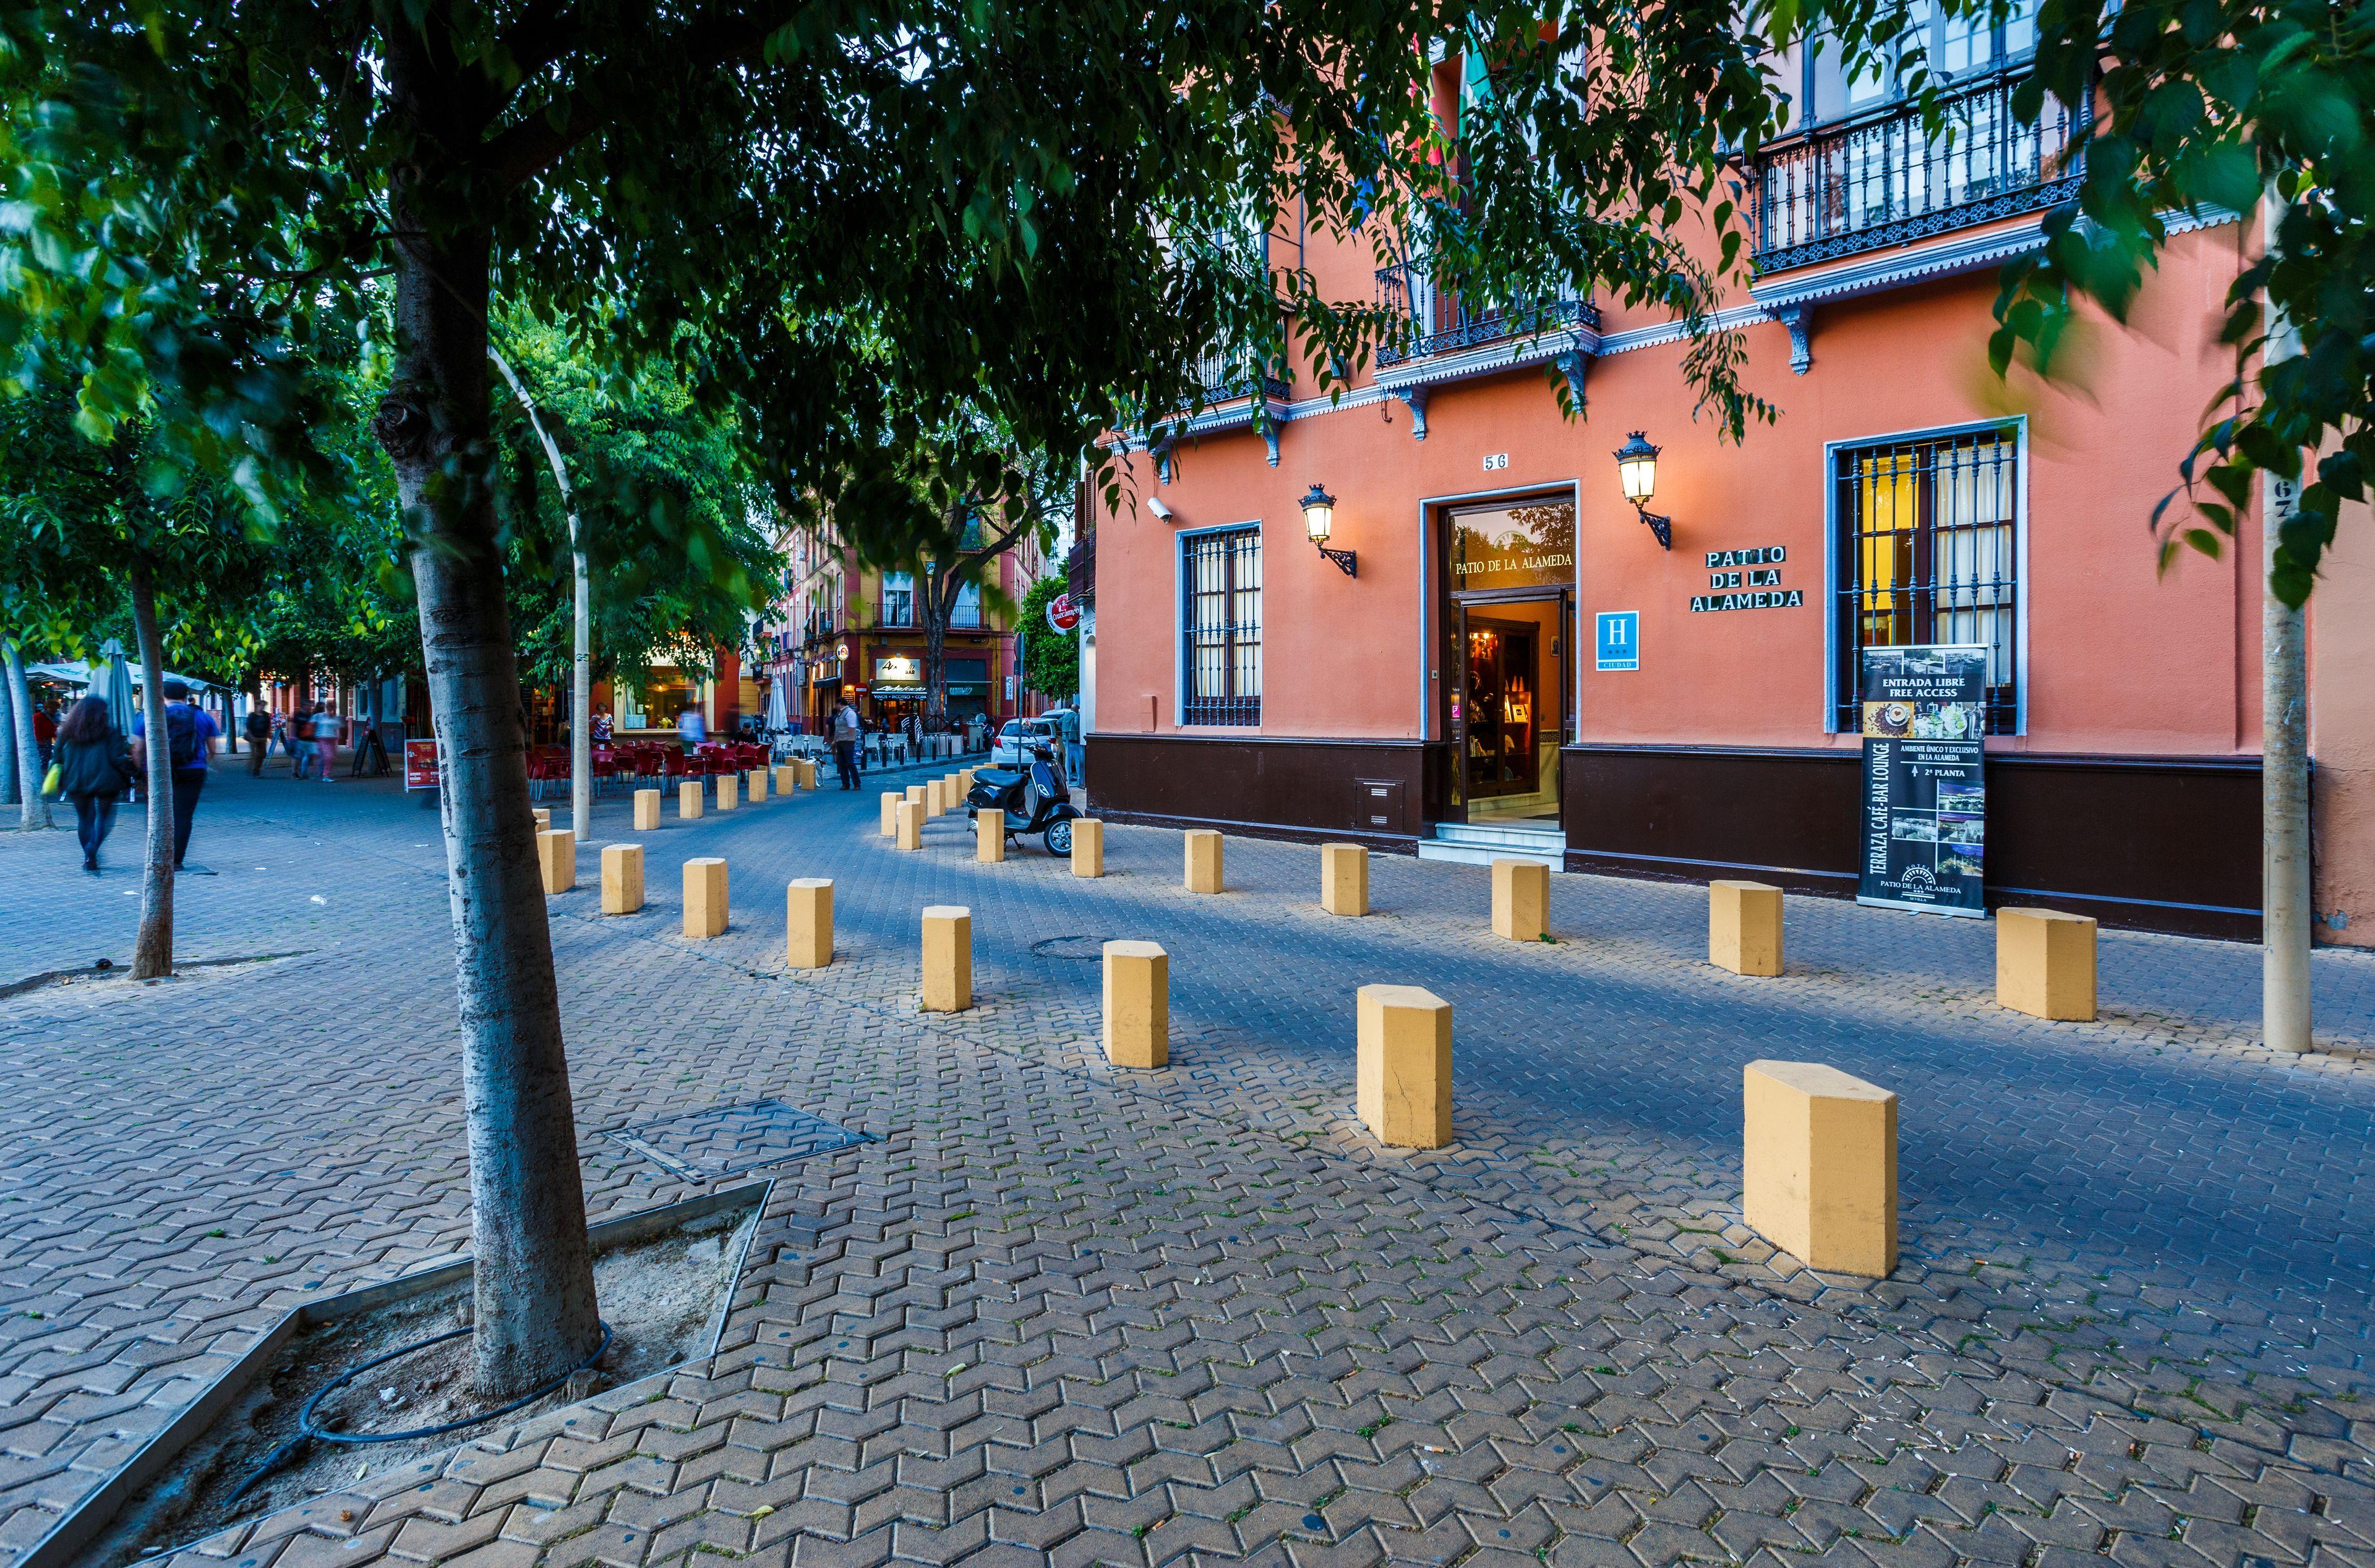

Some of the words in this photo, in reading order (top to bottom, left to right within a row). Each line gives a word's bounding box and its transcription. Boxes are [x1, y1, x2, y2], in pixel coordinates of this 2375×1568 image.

[1485, 454, 1506, 470] 56
[1455, 561, 1484, 575] PATIO
[1487, 560, 1502, 573] DE
[1504, 558, 1517, 571] LA
[1521, 553, 1573, 569] ALAMEDA
[1706, 546, 1785, 568] PATIO
[1711, 572, 1740, 589] DE
[1748, 569, 1779, 587] LA
[1690, 590, 1802, 612] ALAMEDA
[1053, 608, 1080, 621] Cruzcampo
[1607, 619, 1628, 645] H
[1883, 678, 1933, 687] ENTRADA
[1935, 678, 1966, 686] LIBRE
[1889, 689, 1913, 697] FREE
[1915, 688, 1958, 697] ACCESS
[1926, 744, 1944, 752] ÚNICO
[1872, 743, 1889, 781] LOUNGE
[1935, 769, 1966, 777] PLANTA
[1870, 832, 1888, 874] TERRAZA
[1924, 885, 1961, 894] ALAMEDA
